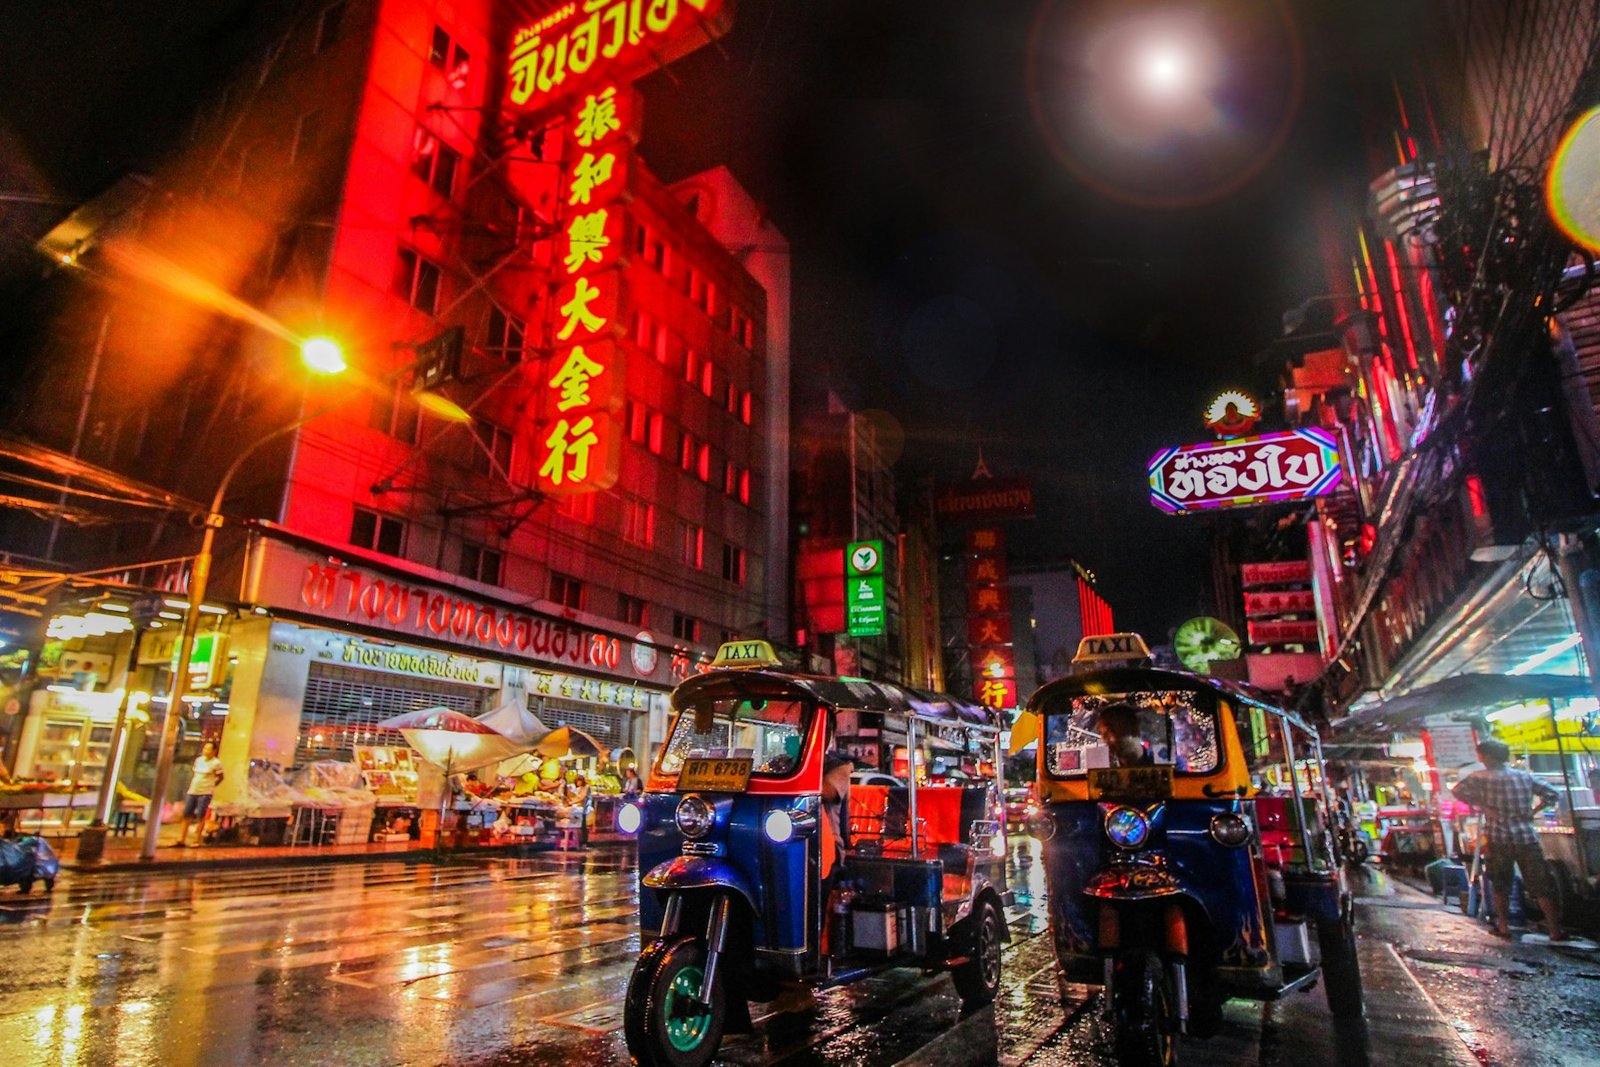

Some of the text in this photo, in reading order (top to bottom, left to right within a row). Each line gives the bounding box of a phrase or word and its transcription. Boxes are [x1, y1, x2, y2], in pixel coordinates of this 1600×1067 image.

[539, 86, 621, 485] 振和興大金行
[1168, 444, 1320, 499] ทองใบ
[723, 643, 760, 660] TAXI
[1087, 637, 1133, 654] TAXI
[714, 762, 748, 776] 6738
